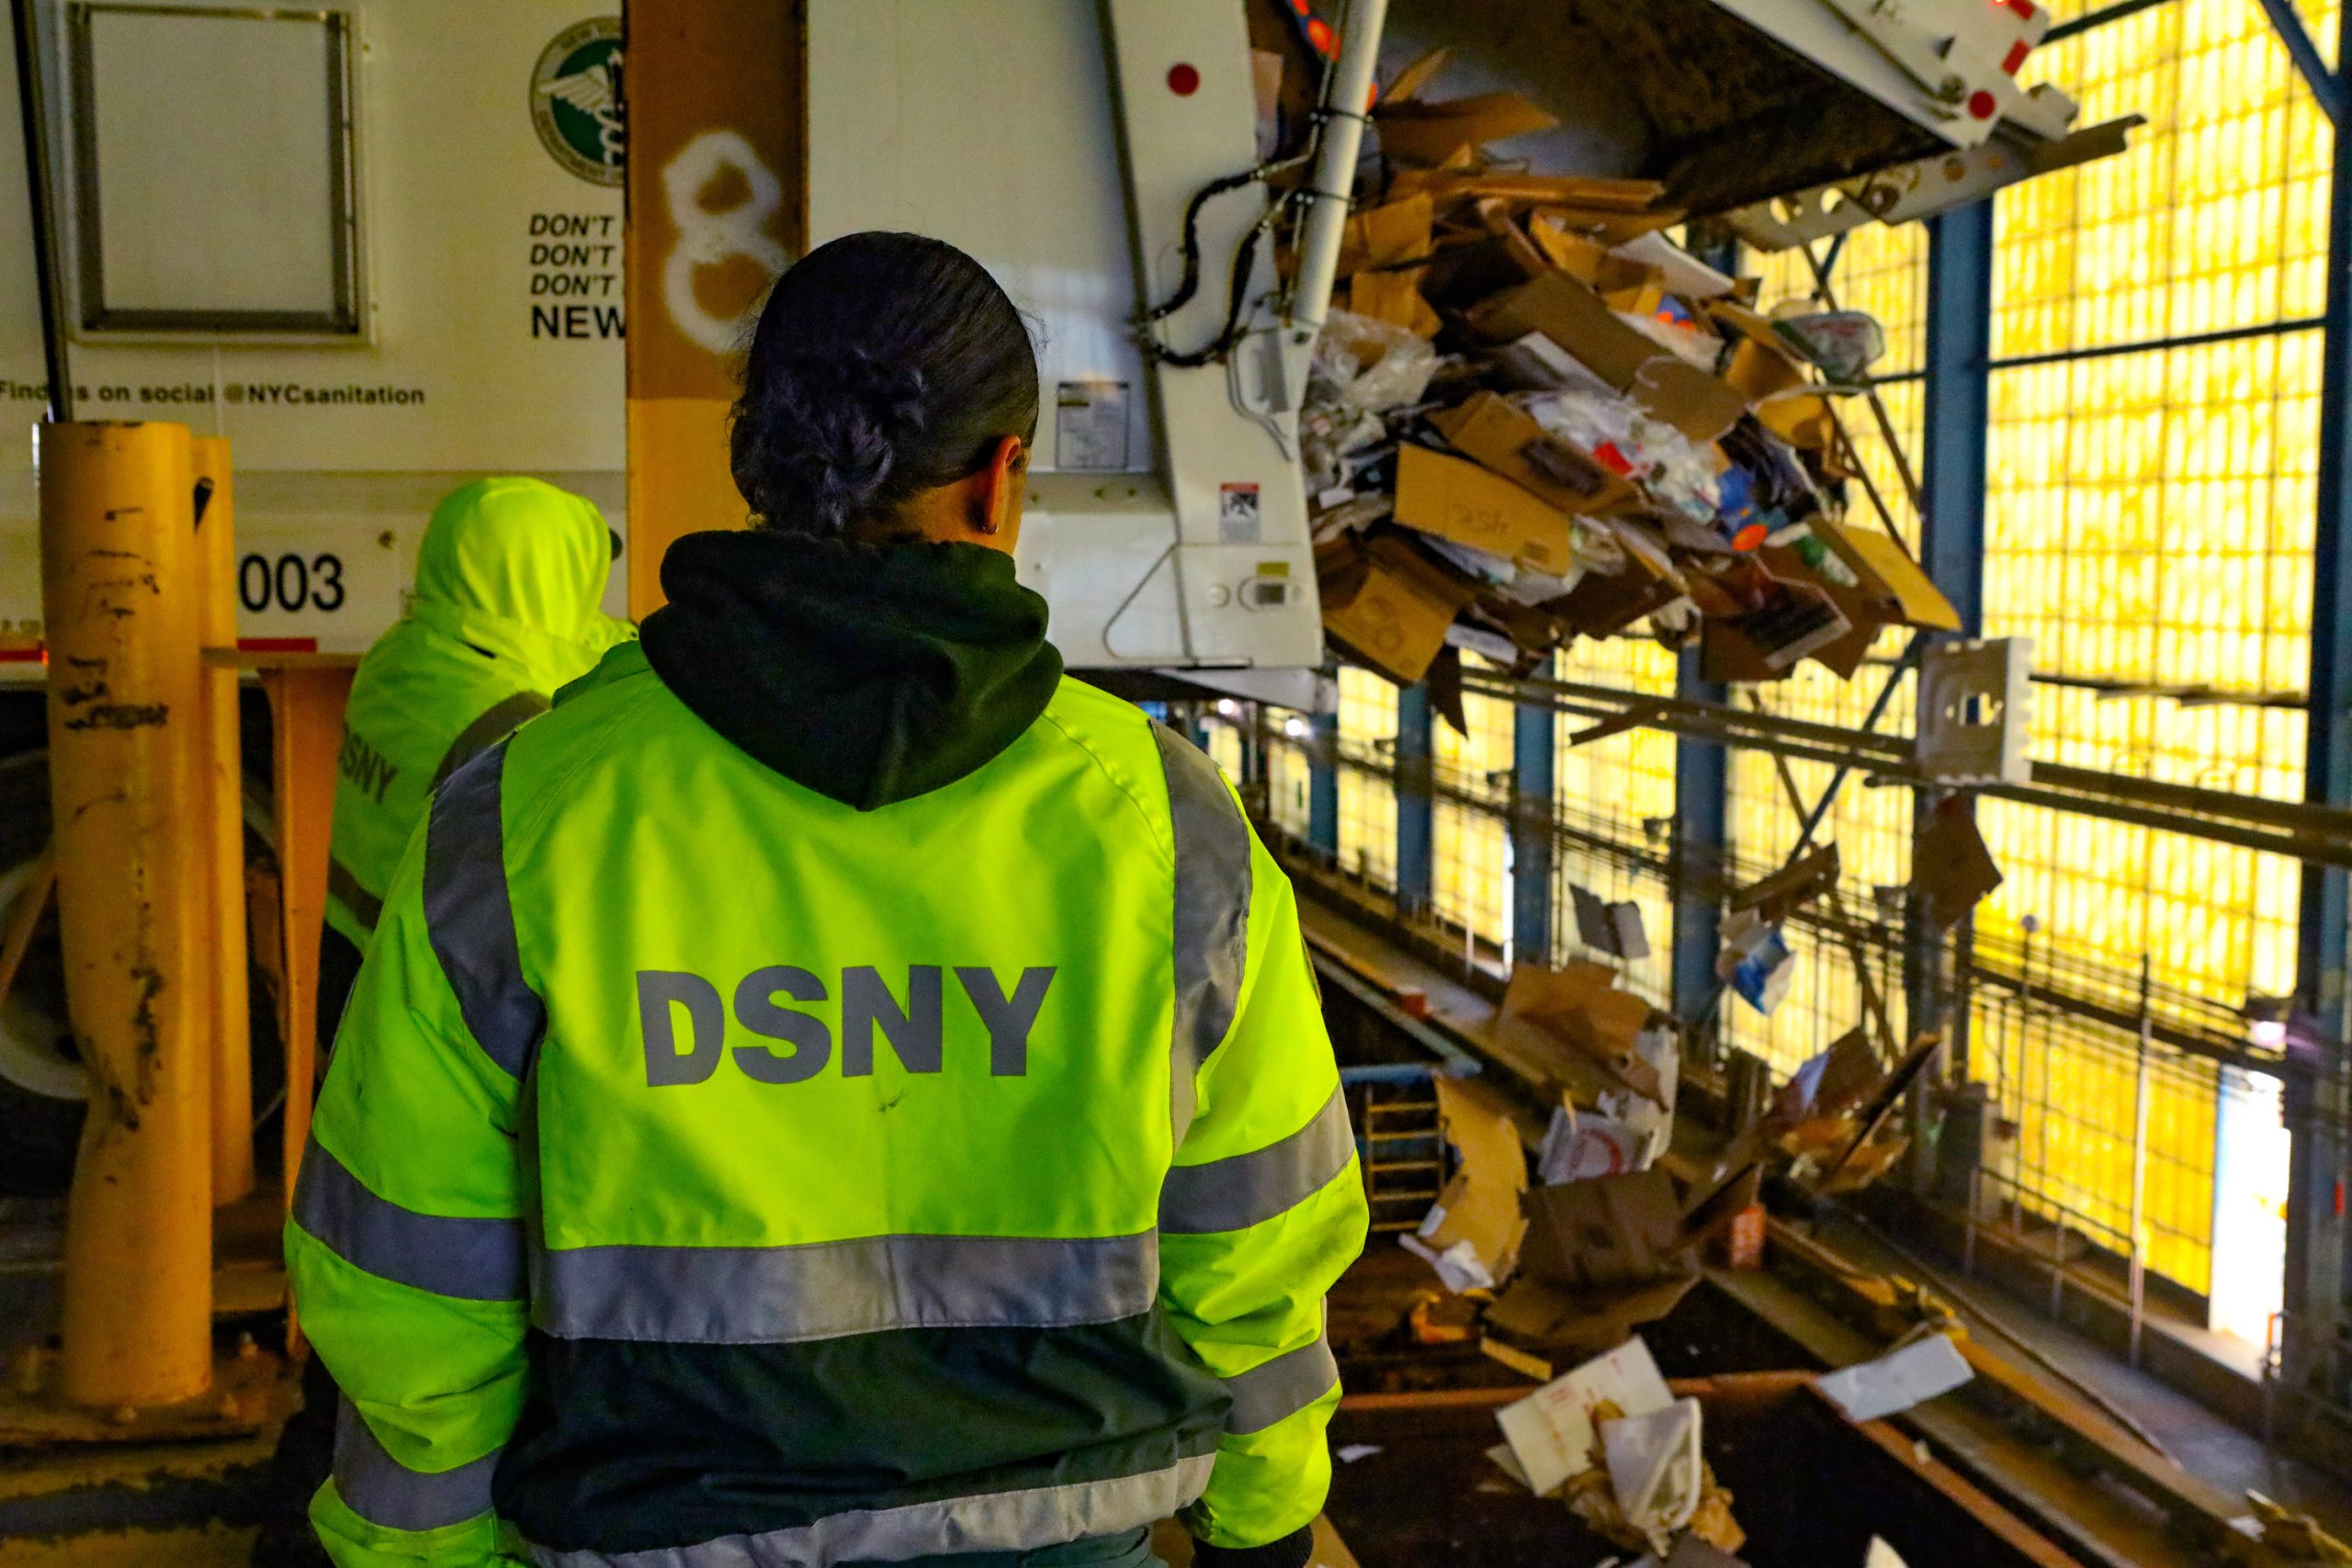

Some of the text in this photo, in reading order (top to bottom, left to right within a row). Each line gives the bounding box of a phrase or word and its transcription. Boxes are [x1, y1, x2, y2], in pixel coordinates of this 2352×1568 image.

[530, 213, 615, 236] DON'T
[530, 243, 615, 266] DON'T
[662, 130, 786, 355] 8
[531, 274, 616, 296] DON'T
[532, 305, 627, 339] NEW
[98, 384, 130, 402] on
[140, 381, 216, 403] social
[223, 382, 425, 405] @NYCsanitation
[240, 554, 345, 613] 003
[636, 964, 1058, 1088] DSNY
